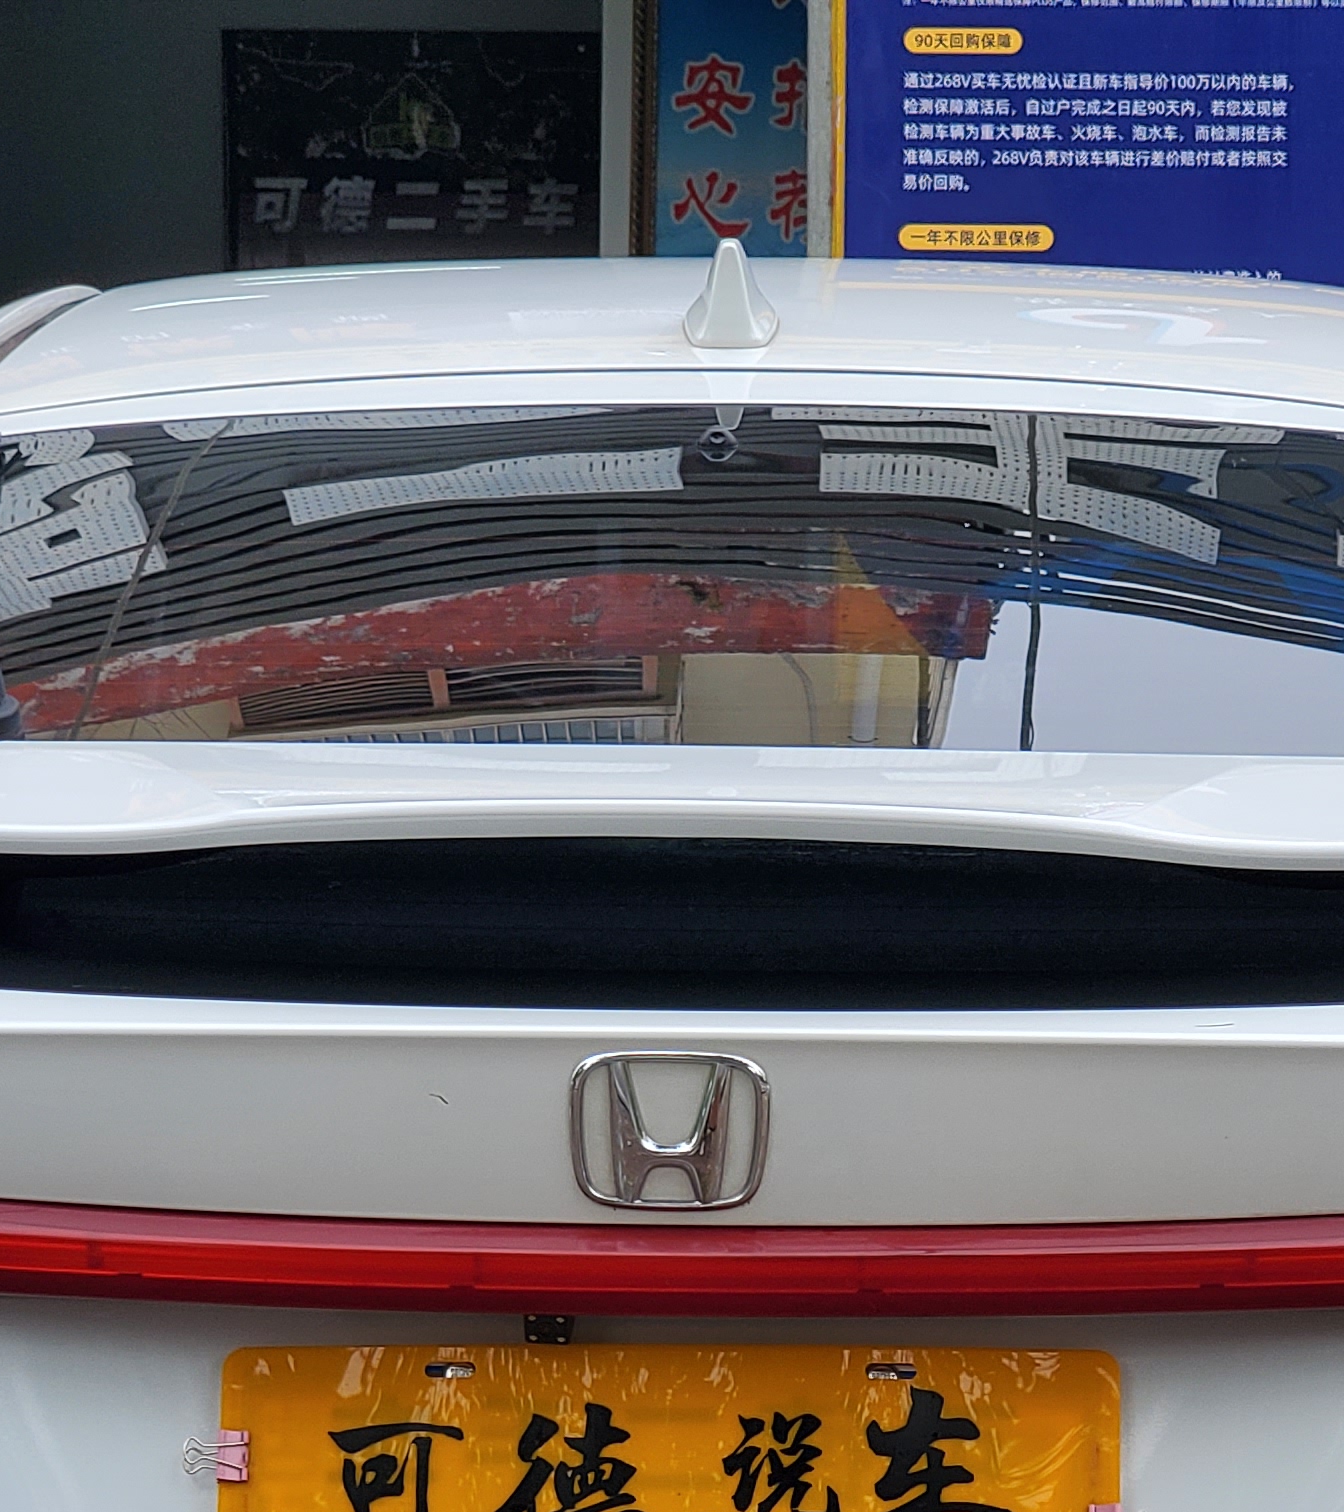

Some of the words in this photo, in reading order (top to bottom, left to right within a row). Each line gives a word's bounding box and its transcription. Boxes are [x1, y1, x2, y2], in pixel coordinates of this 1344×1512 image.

[914, 32, 1012, 49] 90天回购保障
[253, 175, 580, 236] 可德二手车
[909, 229, 1042, 248] 一年不限公里保修
